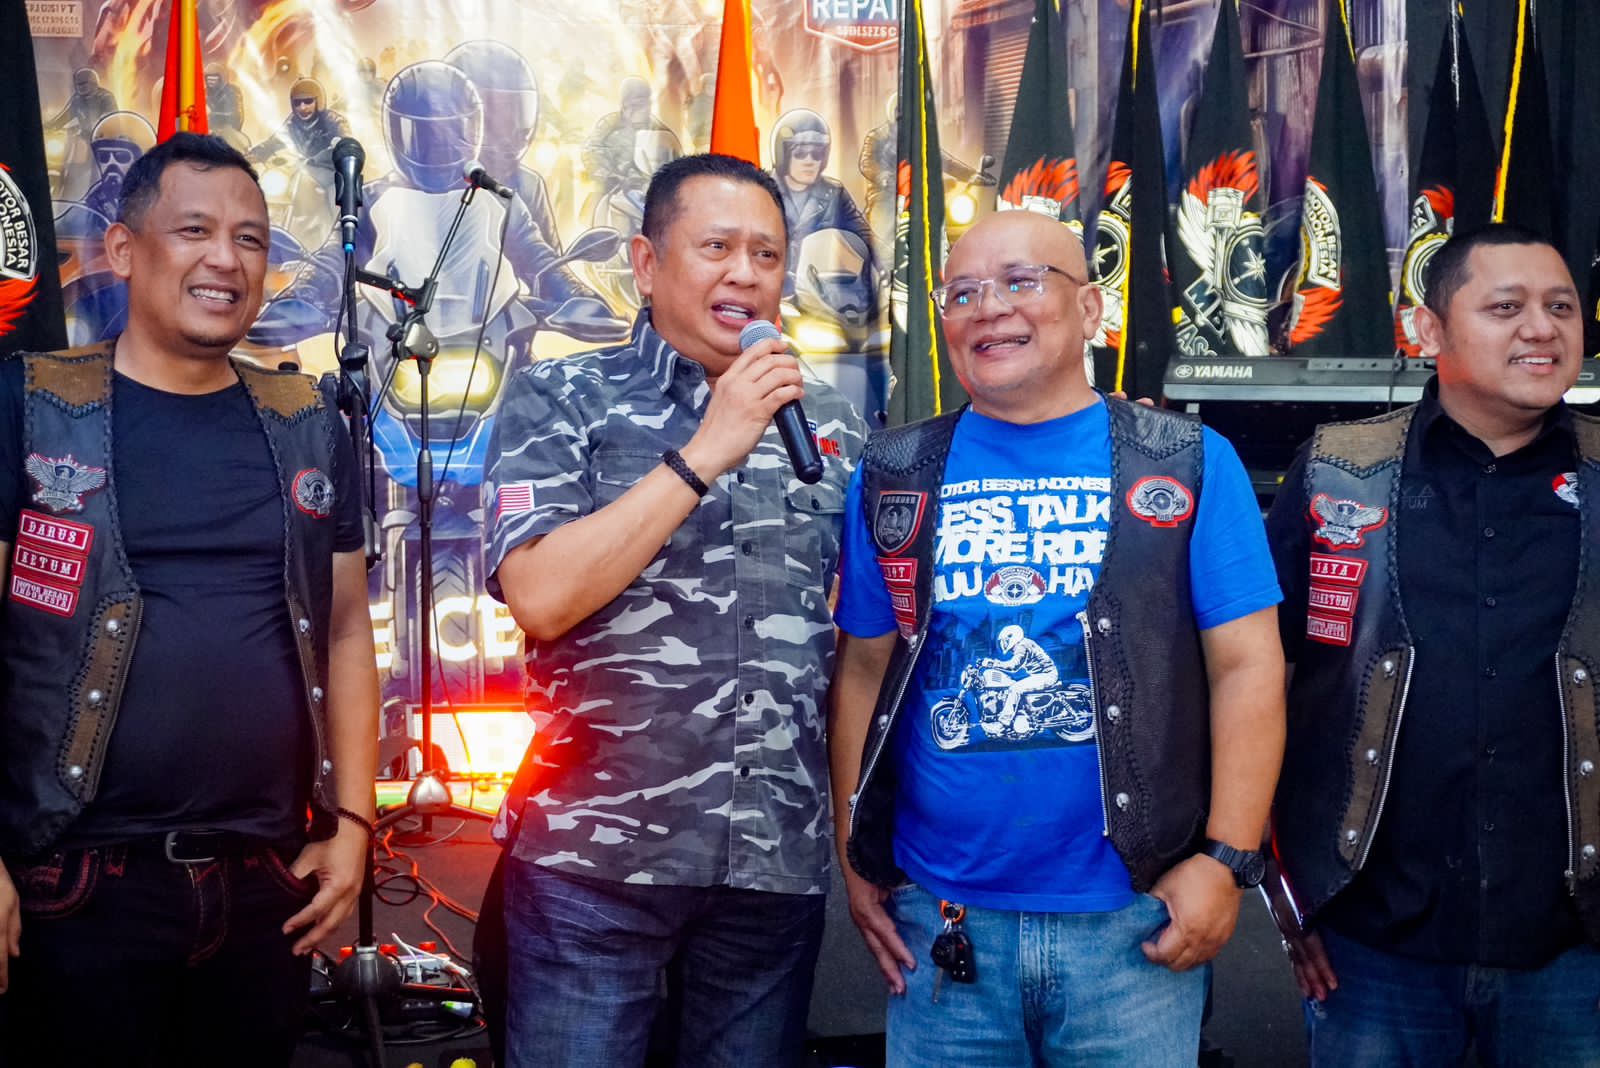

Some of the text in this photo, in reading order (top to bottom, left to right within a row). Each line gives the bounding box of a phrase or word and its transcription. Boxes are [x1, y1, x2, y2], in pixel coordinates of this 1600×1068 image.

[812, 0, 897, 19] REPAI
[14, 220, 29, 268] BESAR
[1326, 235, 1337, 279] BESAR
[1194, 366, 1253, 378] YAMAHA
[941, 477, 1111, 498] OTOR BESAR INDONESI
[937, 497, 1016, 534] ESS
[28, 521, 77, 543] DARUS
[1316, 562, 1349, 577] JAYA
